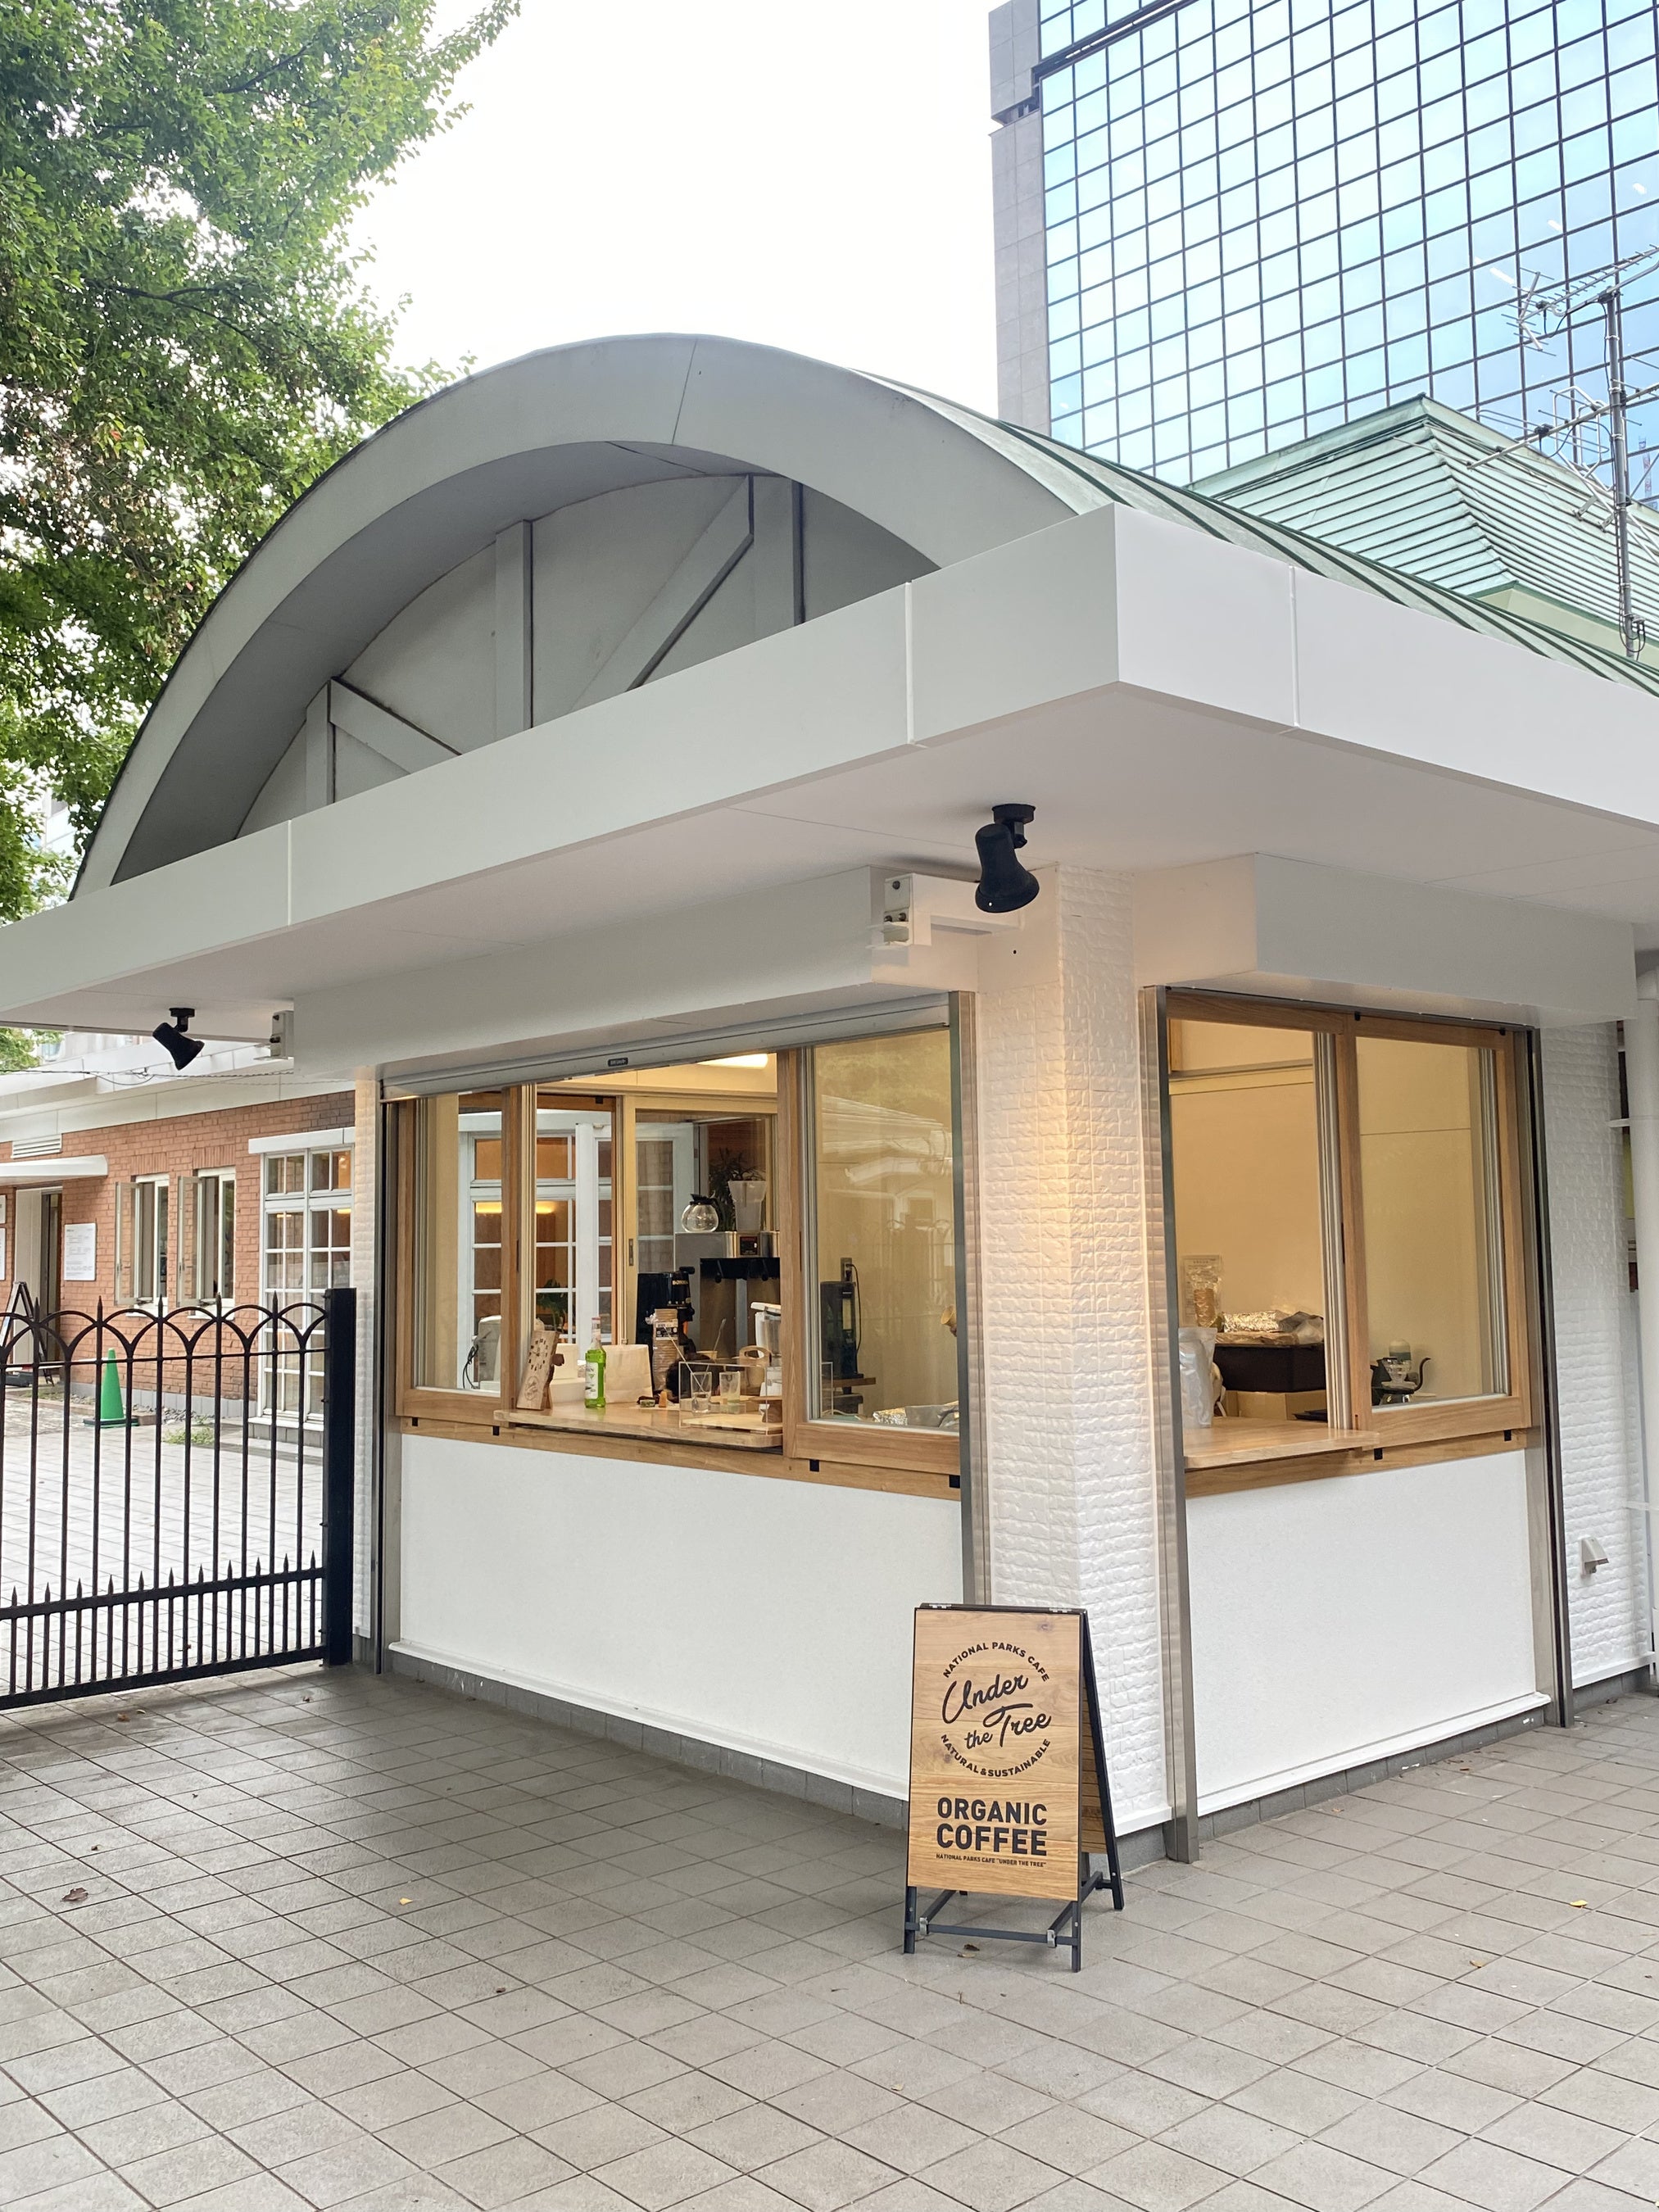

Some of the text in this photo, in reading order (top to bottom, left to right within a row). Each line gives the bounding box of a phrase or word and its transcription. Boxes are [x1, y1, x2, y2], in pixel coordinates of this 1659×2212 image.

[943, 1642, 1049, 1682] NATIONAL PARKS CAFE
[942, 1674, 1029, 1724] Under
[964, 1703, 1052, 1749] the Tree
[937, 1797, 1047, 1825] ORGANIC
[936, 1823, 1047, 1856] COFFEE
